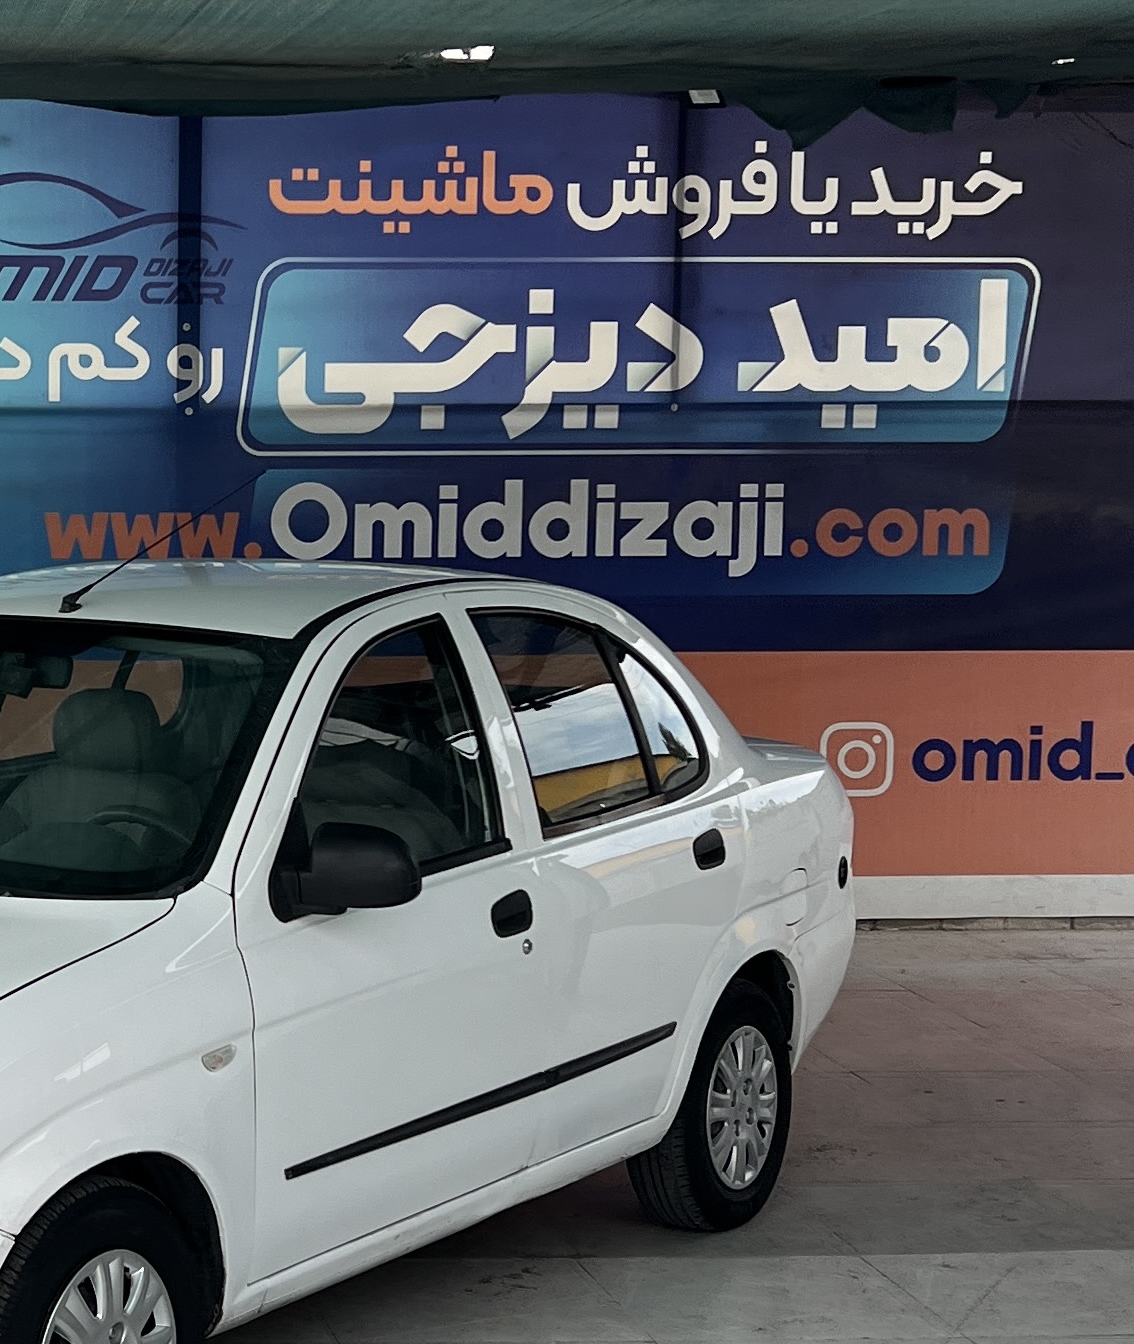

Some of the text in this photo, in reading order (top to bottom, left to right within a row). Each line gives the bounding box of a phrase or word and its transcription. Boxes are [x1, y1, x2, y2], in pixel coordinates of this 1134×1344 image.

[268, 140, 1024, 240] خرید یا فروش ماشینت
[139, 281, 226, 305] CAR
[142, 258, 234, 278] DIZAJI
[47, 316, 151, 403] کم
[166, 343, 224, 404] رو
[277, 278, 1010, 440] امید دیزجی
[44, 479, 991, 577] www.Omiddizaji.com
[912, 720, 1134, 782] omid_
